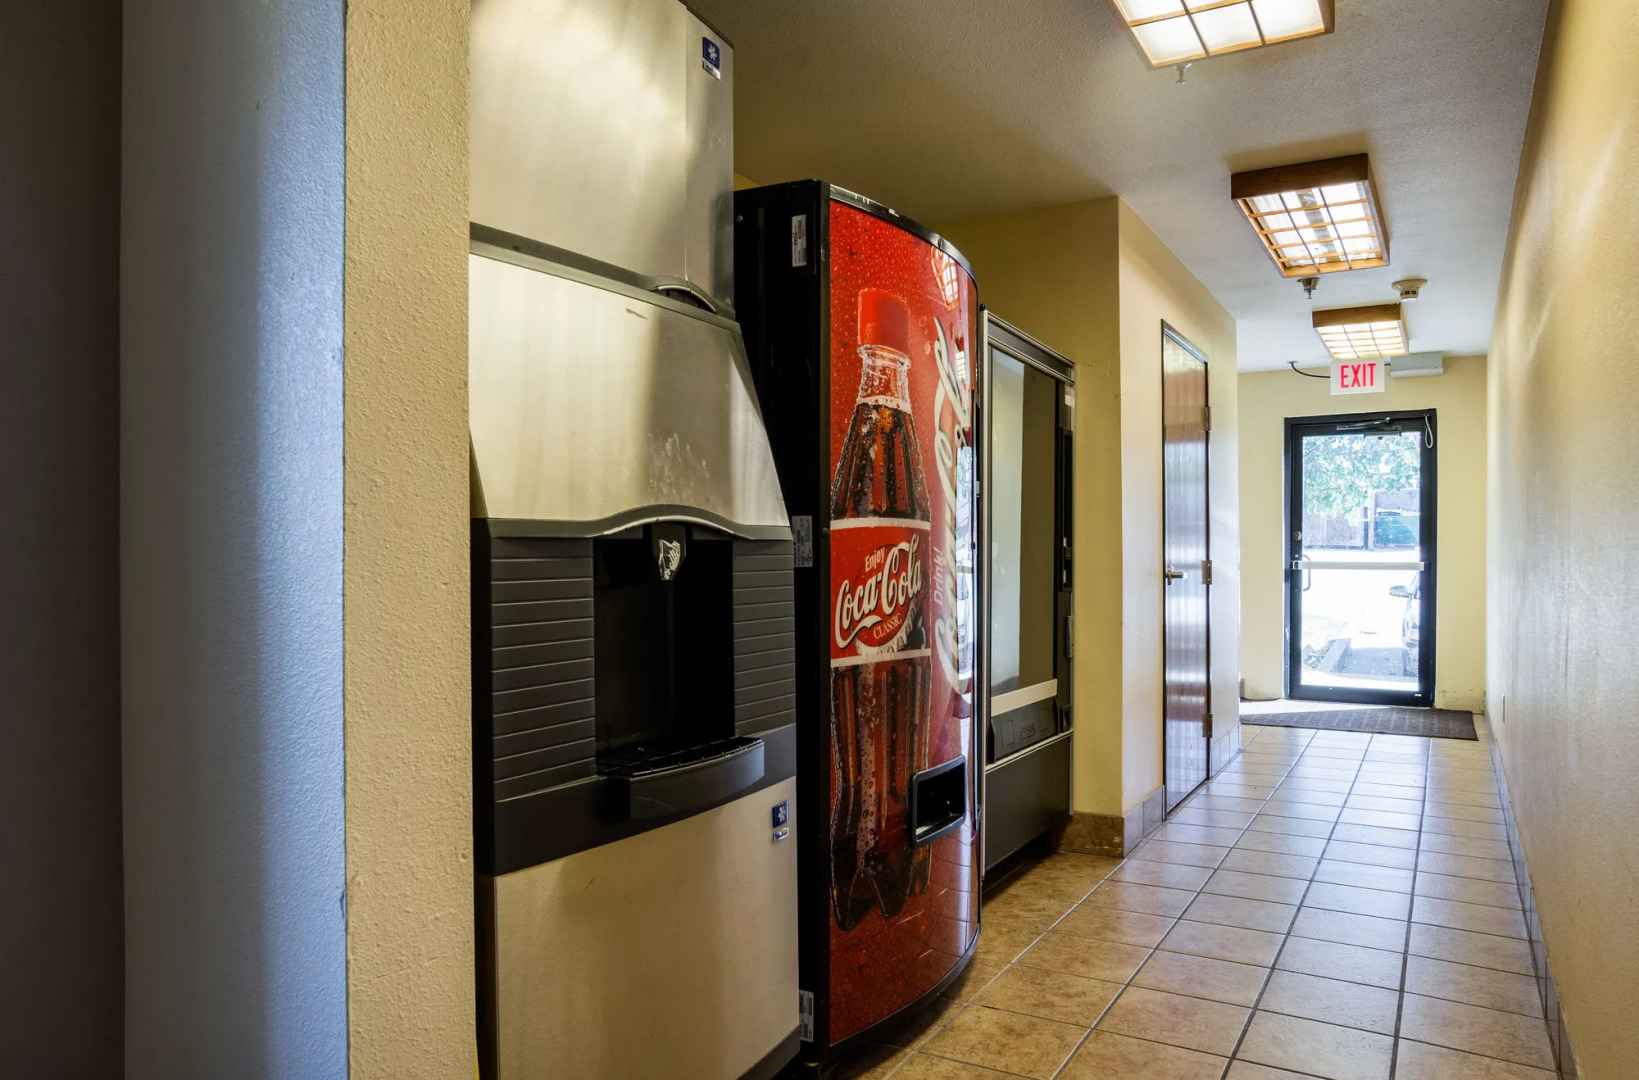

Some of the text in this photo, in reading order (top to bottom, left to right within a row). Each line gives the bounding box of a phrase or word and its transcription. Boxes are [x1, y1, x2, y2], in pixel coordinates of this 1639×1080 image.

[1340, 363, 1376, 388] EXIT
[865, 547, 885, 572] Enjoy
[835, 533, 922, 648] Coca-Cola
[873, 611, 903, 640] CLASSIC
